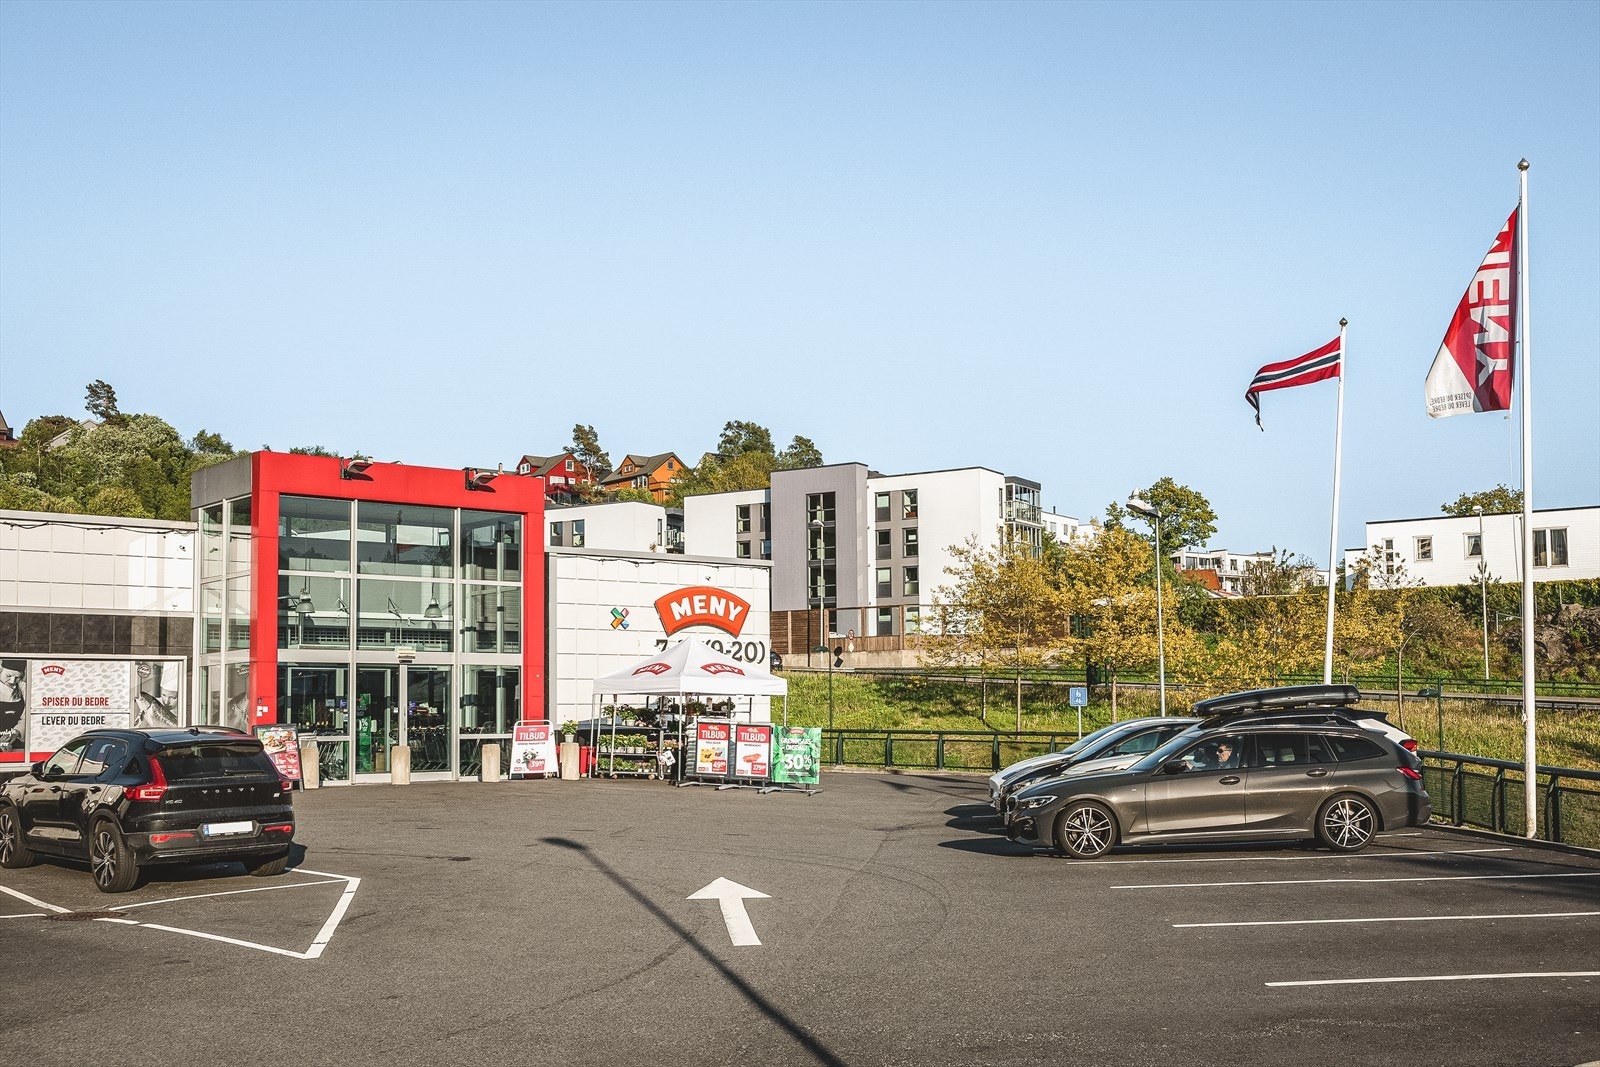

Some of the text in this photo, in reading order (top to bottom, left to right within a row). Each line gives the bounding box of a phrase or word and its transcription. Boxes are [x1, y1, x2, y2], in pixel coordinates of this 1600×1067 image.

[669, 594, 743, 622] MENY
[44, 666, 62, 674] MENY
[42, 697, 110, 707] SPISER DU BEDRE
[41, 716, 106, 726] LEVER DU BEDRE
[518, 731, 546, 740] TILBUD
[701, 730, 726, 740] TILBUD
[740, 732, 767, 742] TILBUD
